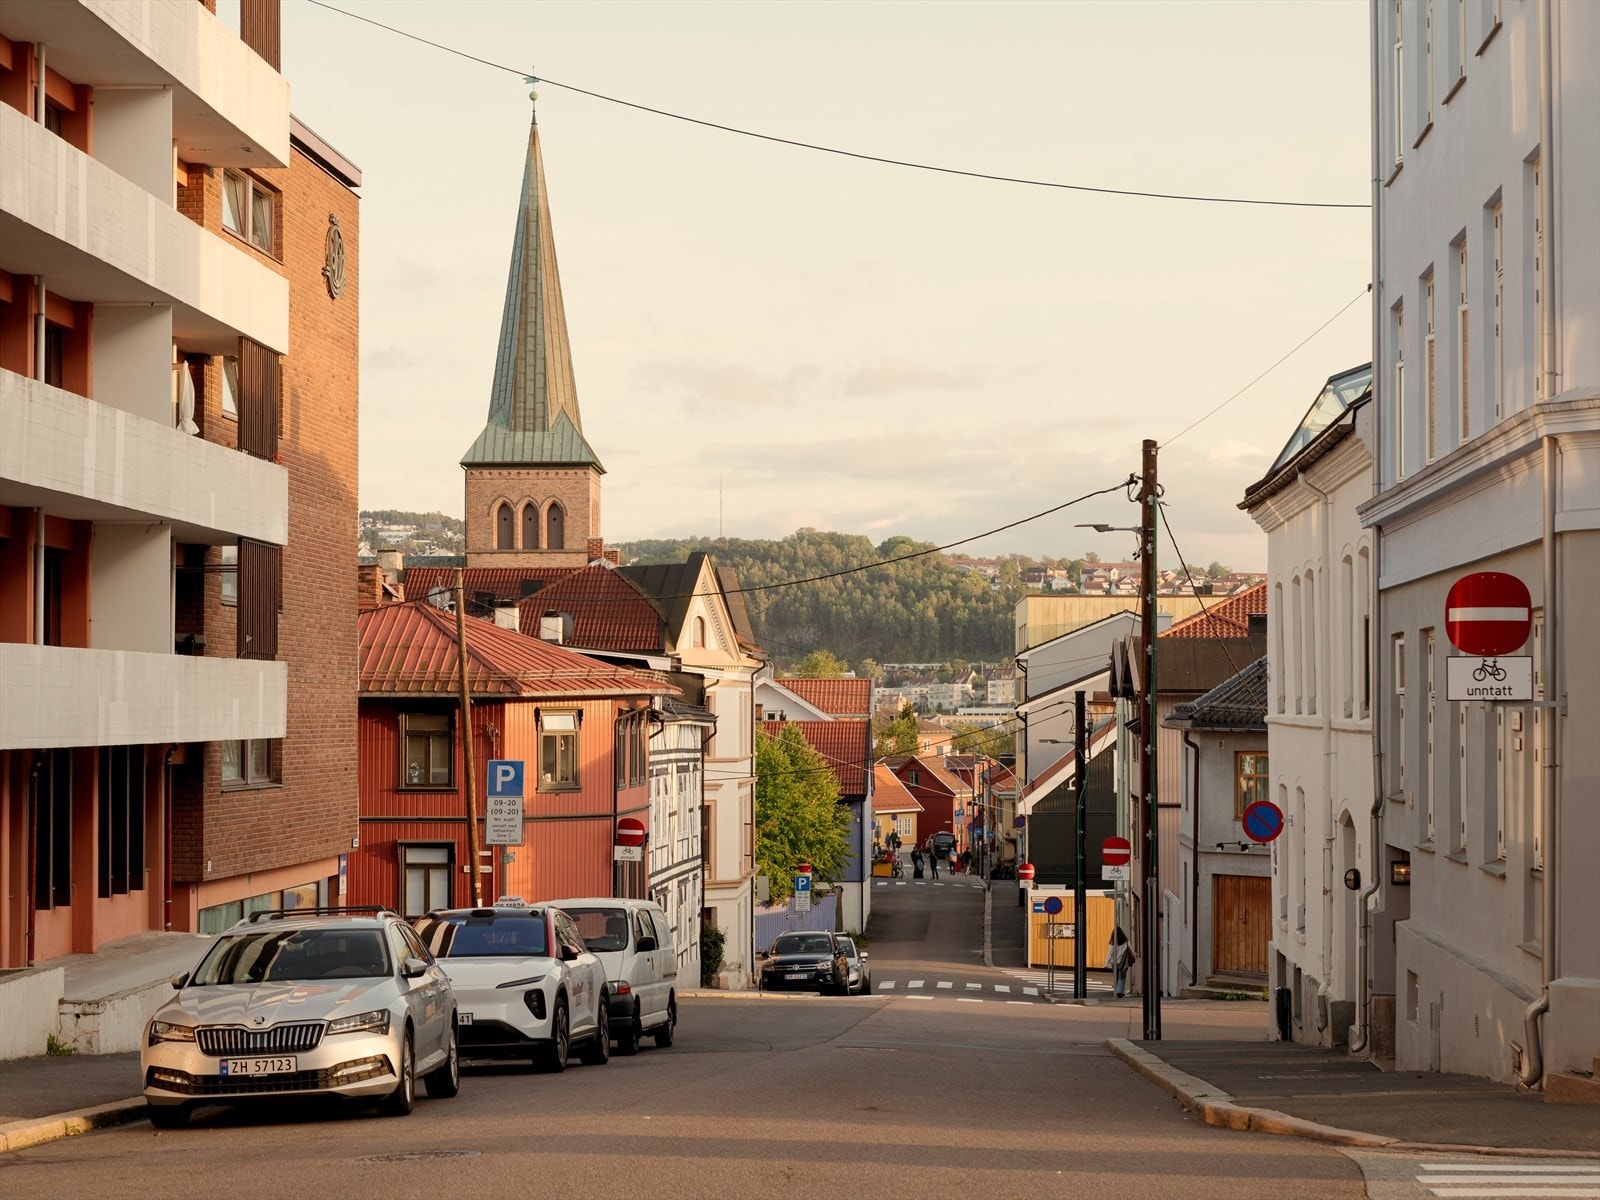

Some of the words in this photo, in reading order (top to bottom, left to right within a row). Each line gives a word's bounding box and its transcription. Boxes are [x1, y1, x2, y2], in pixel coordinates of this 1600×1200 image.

[1466, 686, 1513, 697] unntatt
[497, 765, 515, 792] P
[798, 878, 807, 890] P
[231, 1061, 248, 1074] ZH
[254, 1058, 292, 1073] 57123
